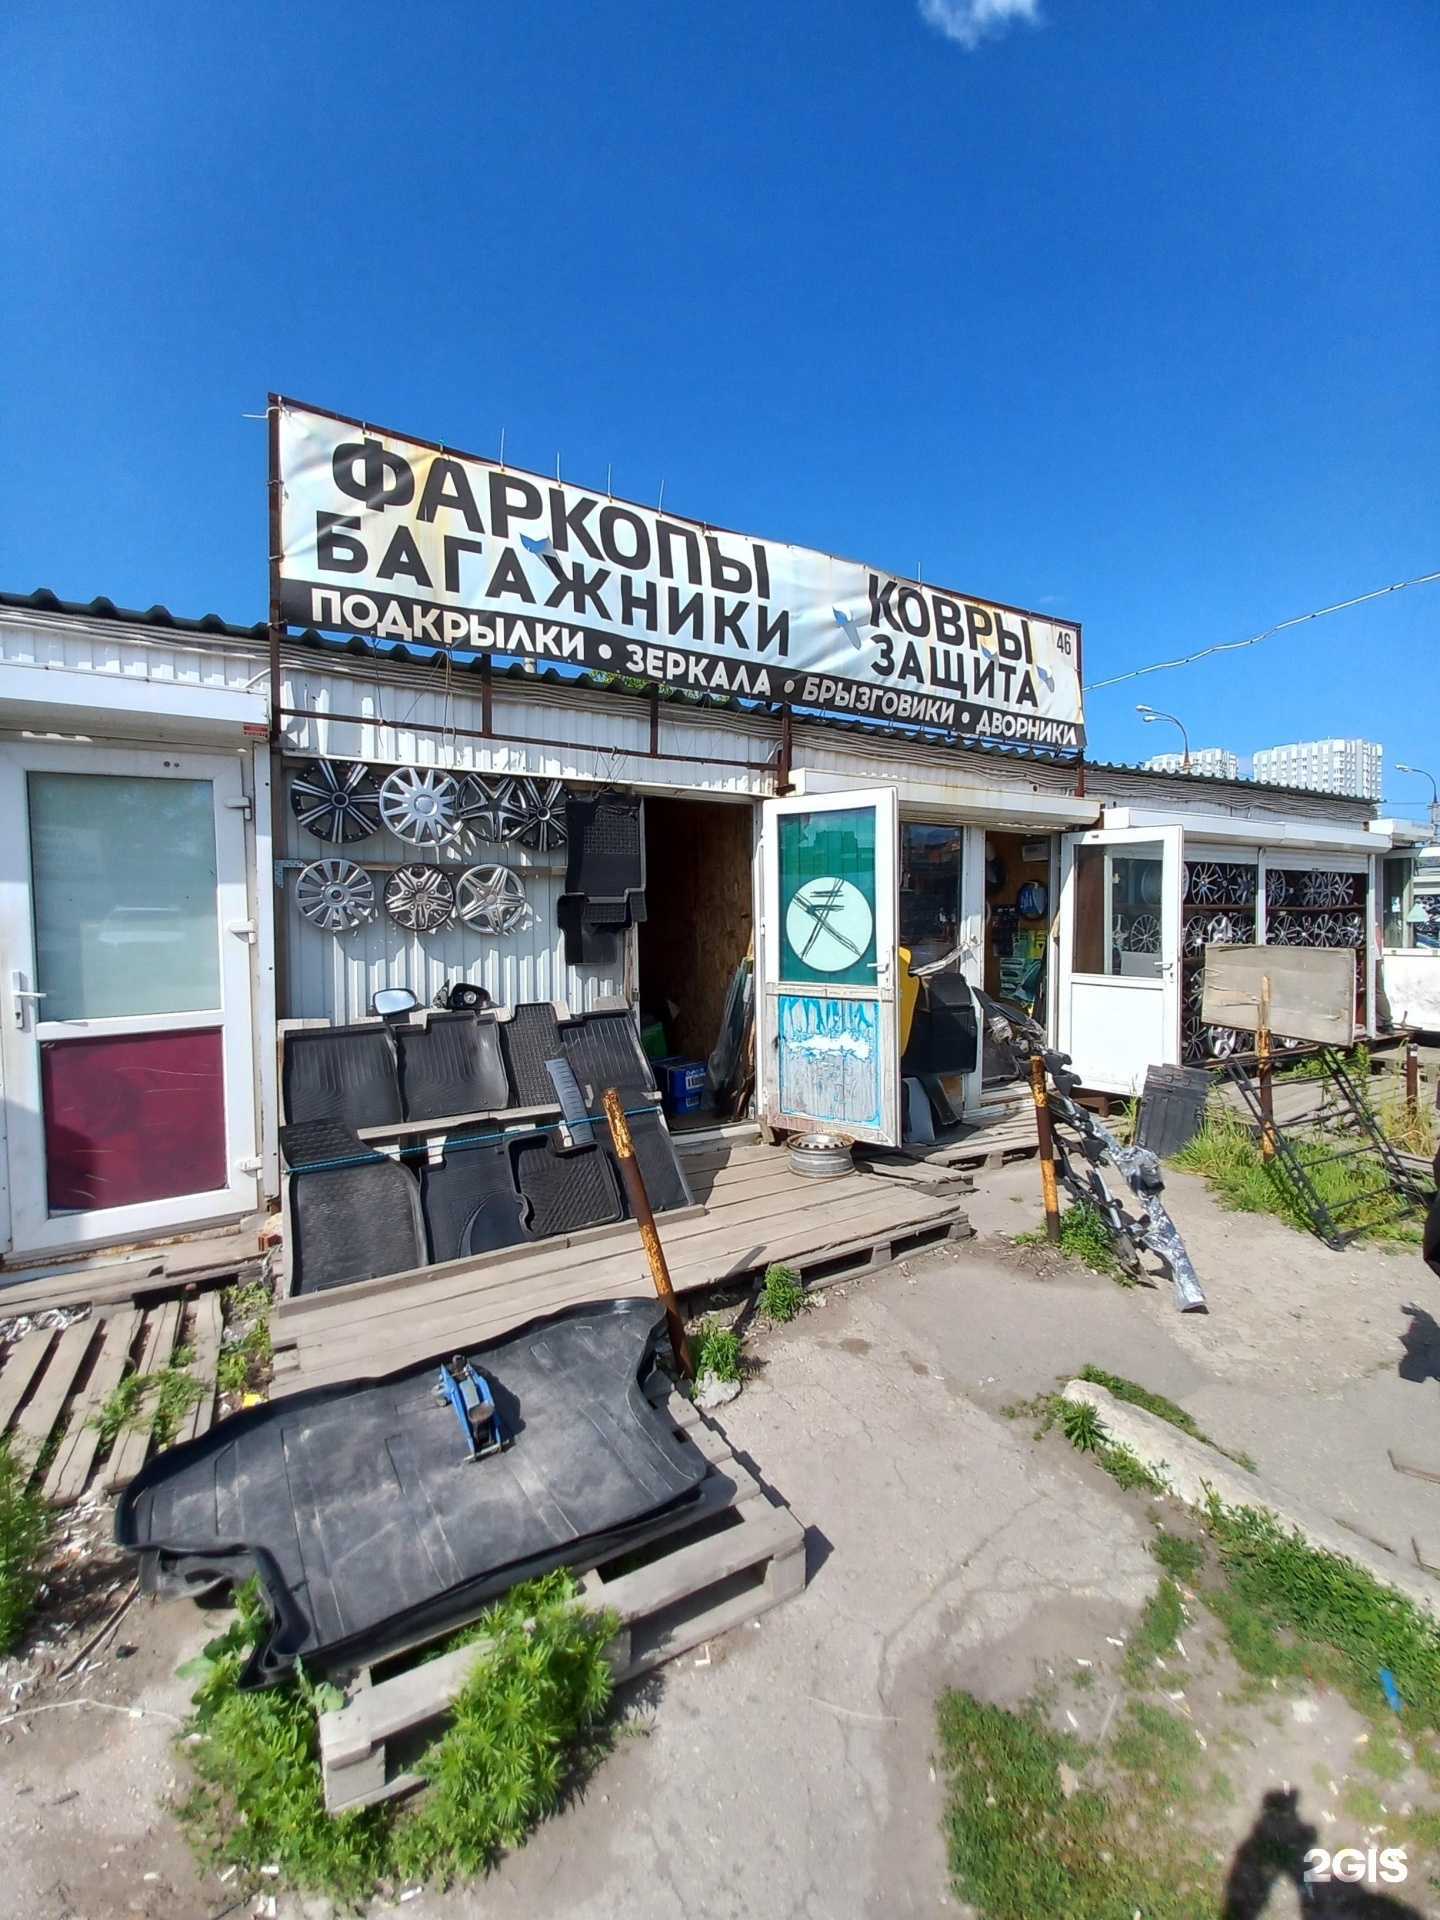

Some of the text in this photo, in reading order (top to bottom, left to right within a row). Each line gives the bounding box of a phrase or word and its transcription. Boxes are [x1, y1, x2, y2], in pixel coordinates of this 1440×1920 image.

[333, 438, 771, 598] ФАРКОПЫ
[316, 511, 790, 656] БАГАЖНИКИ
[868, 573, 1033, 664] КОВРЫ
[312, 588, 1077, 745] ПОДКРЫЛКИ ЗЕРКАЛА БРЫЗГОВИКИ ДВОРНИКИ
[870, 634, 1038, 708] ЗАЩИТА
[1056, 631, 1071, 655] 46
